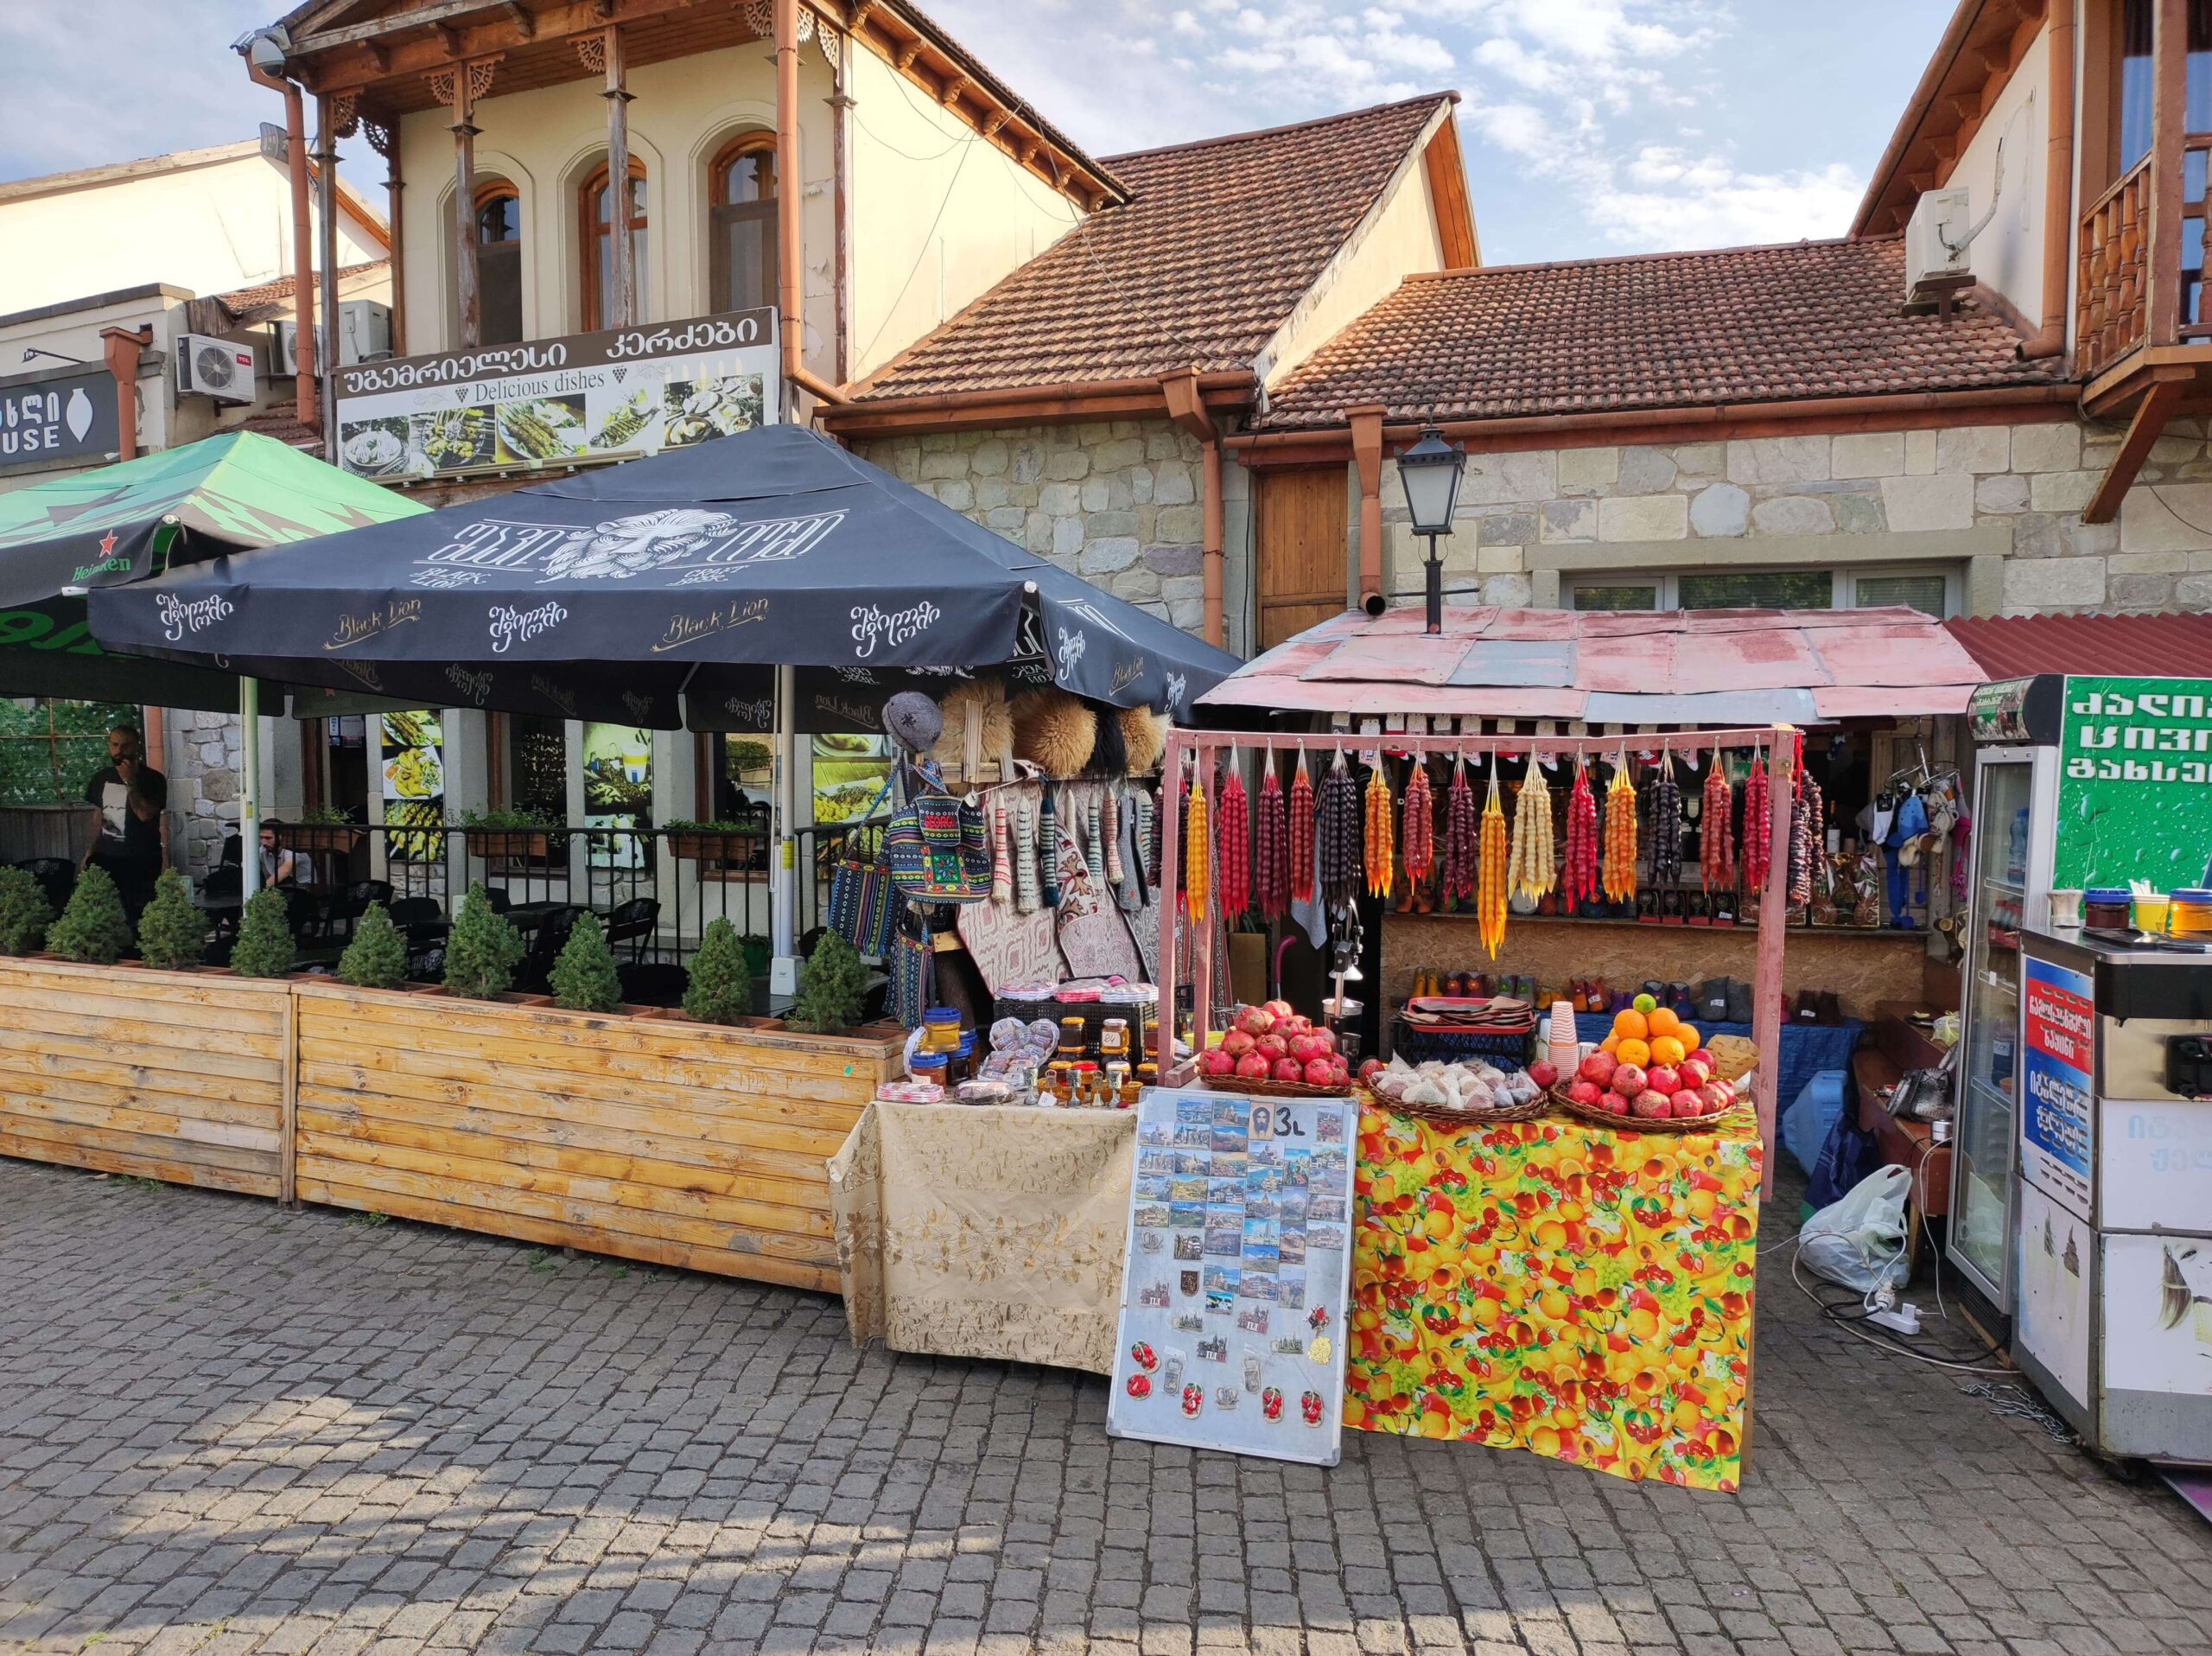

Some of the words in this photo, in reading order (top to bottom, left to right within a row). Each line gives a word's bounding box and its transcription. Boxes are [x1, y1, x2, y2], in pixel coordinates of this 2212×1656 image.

[343, 343, 567, 393] უგემრიელესი
[606, 317, 758, 359] კერძები
[475, 374, 550, 403] Delicious
[554, 370, 605, 392] dishes
[0, 392, 60, 428] ხლი
[333, 610, 381, 642] Black
[388, 598, 422, 621] Lion
[662, 610, 723, 644] Black
[728, 598, 770, 625] Lion
[2066, 757, 2212, 784] გახსე
